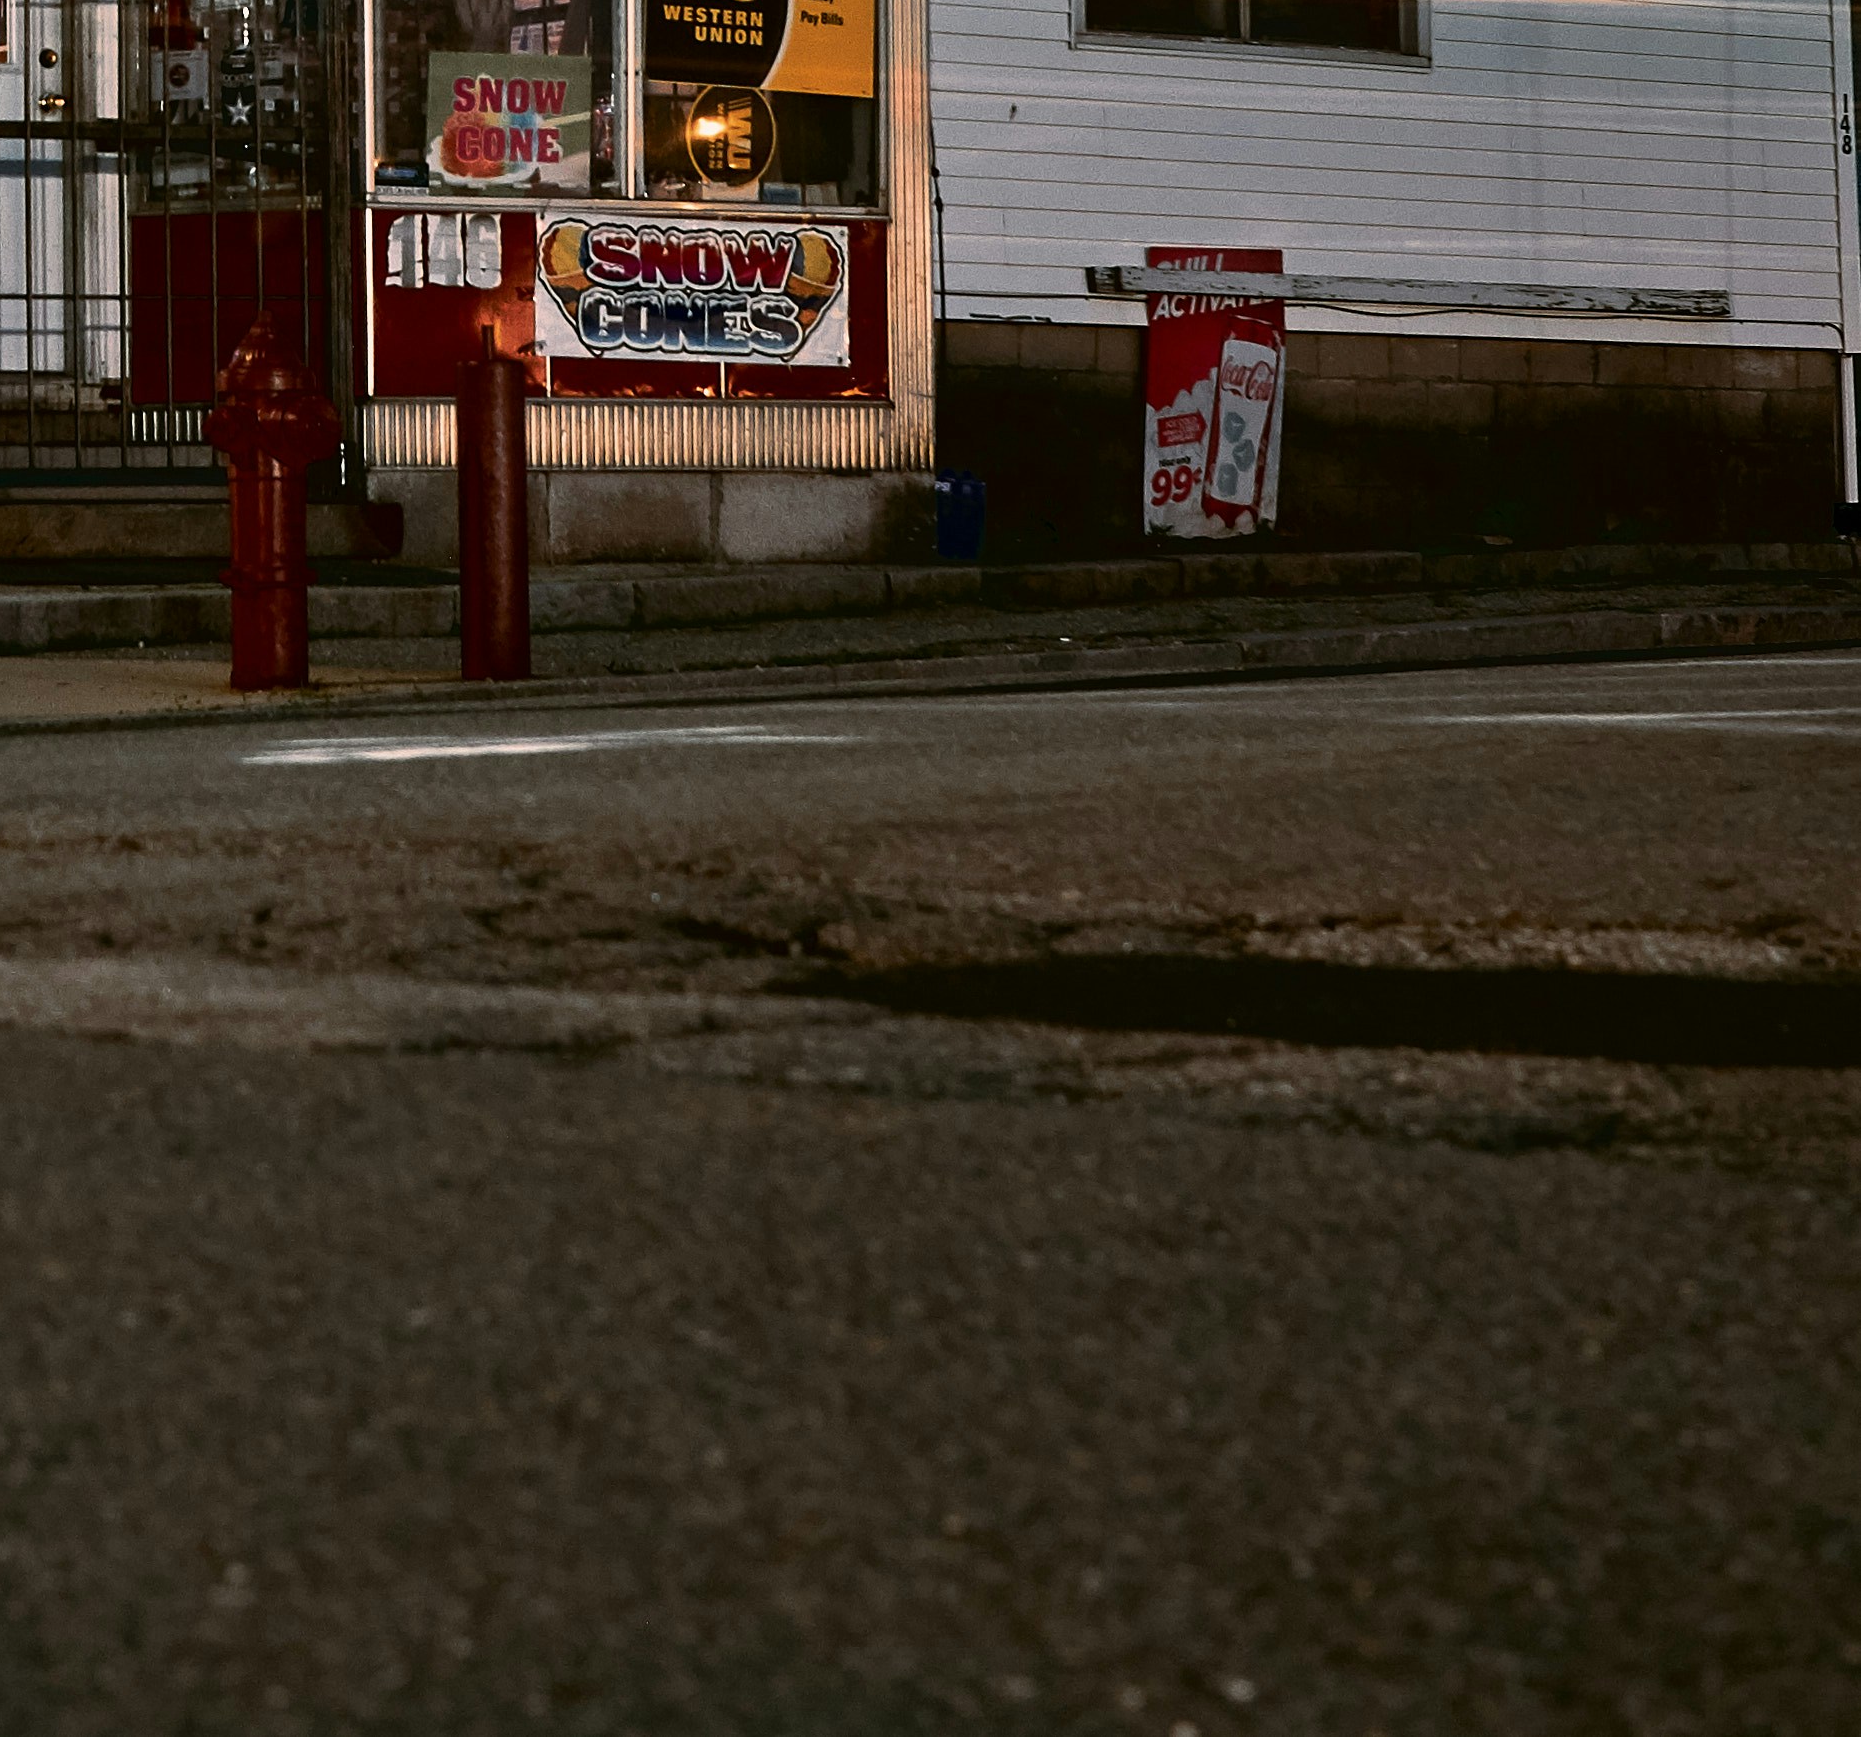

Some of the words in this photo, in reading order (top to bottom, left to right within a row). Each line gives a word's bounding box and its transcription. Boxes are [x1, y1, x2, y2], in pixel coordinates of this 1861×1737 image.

[663, 4, 764, 27] WESTERN
[800, 9, 820, 26] Pay
[820, 11, 845, 26] Bills
[694, 26, 764, 47] UNION
[452, 77, 568, 115] SNOW
[1840, 93, 1852, 155] 148
[456, 127, 561, 163] CONE
[585, 225, 797, 293] SNOW
[577, 285, 804, 355] CONES
